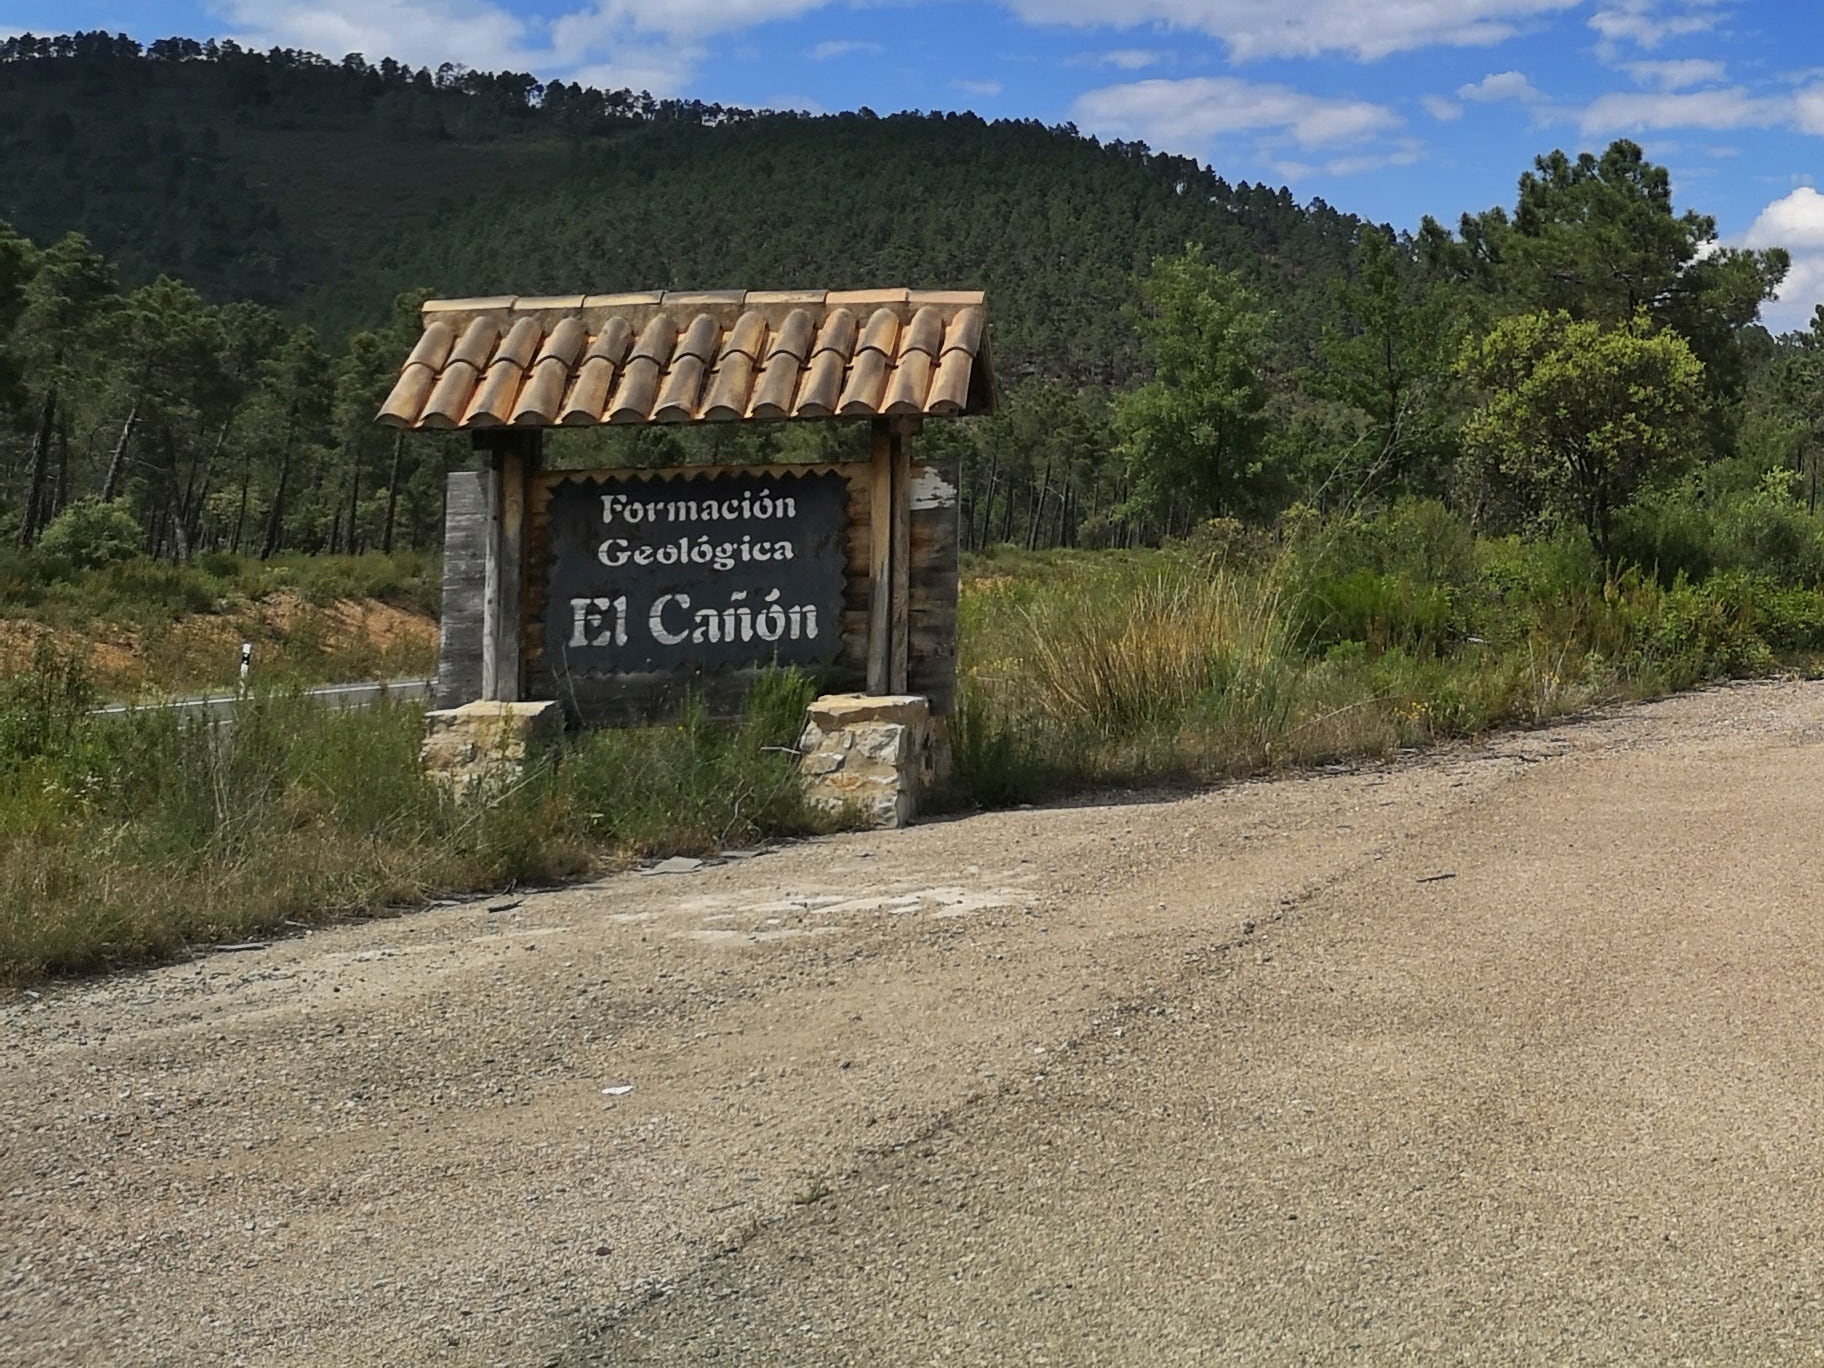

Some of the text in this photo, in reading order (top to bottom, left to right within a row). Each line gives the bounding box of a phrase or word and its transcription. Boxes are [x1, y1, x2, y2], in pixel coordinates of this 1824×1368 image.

[600, 489, 797, 524] Formación
[597, 535, 795, 571] Geológica
[569, 588, 819, 648] El Cañón
